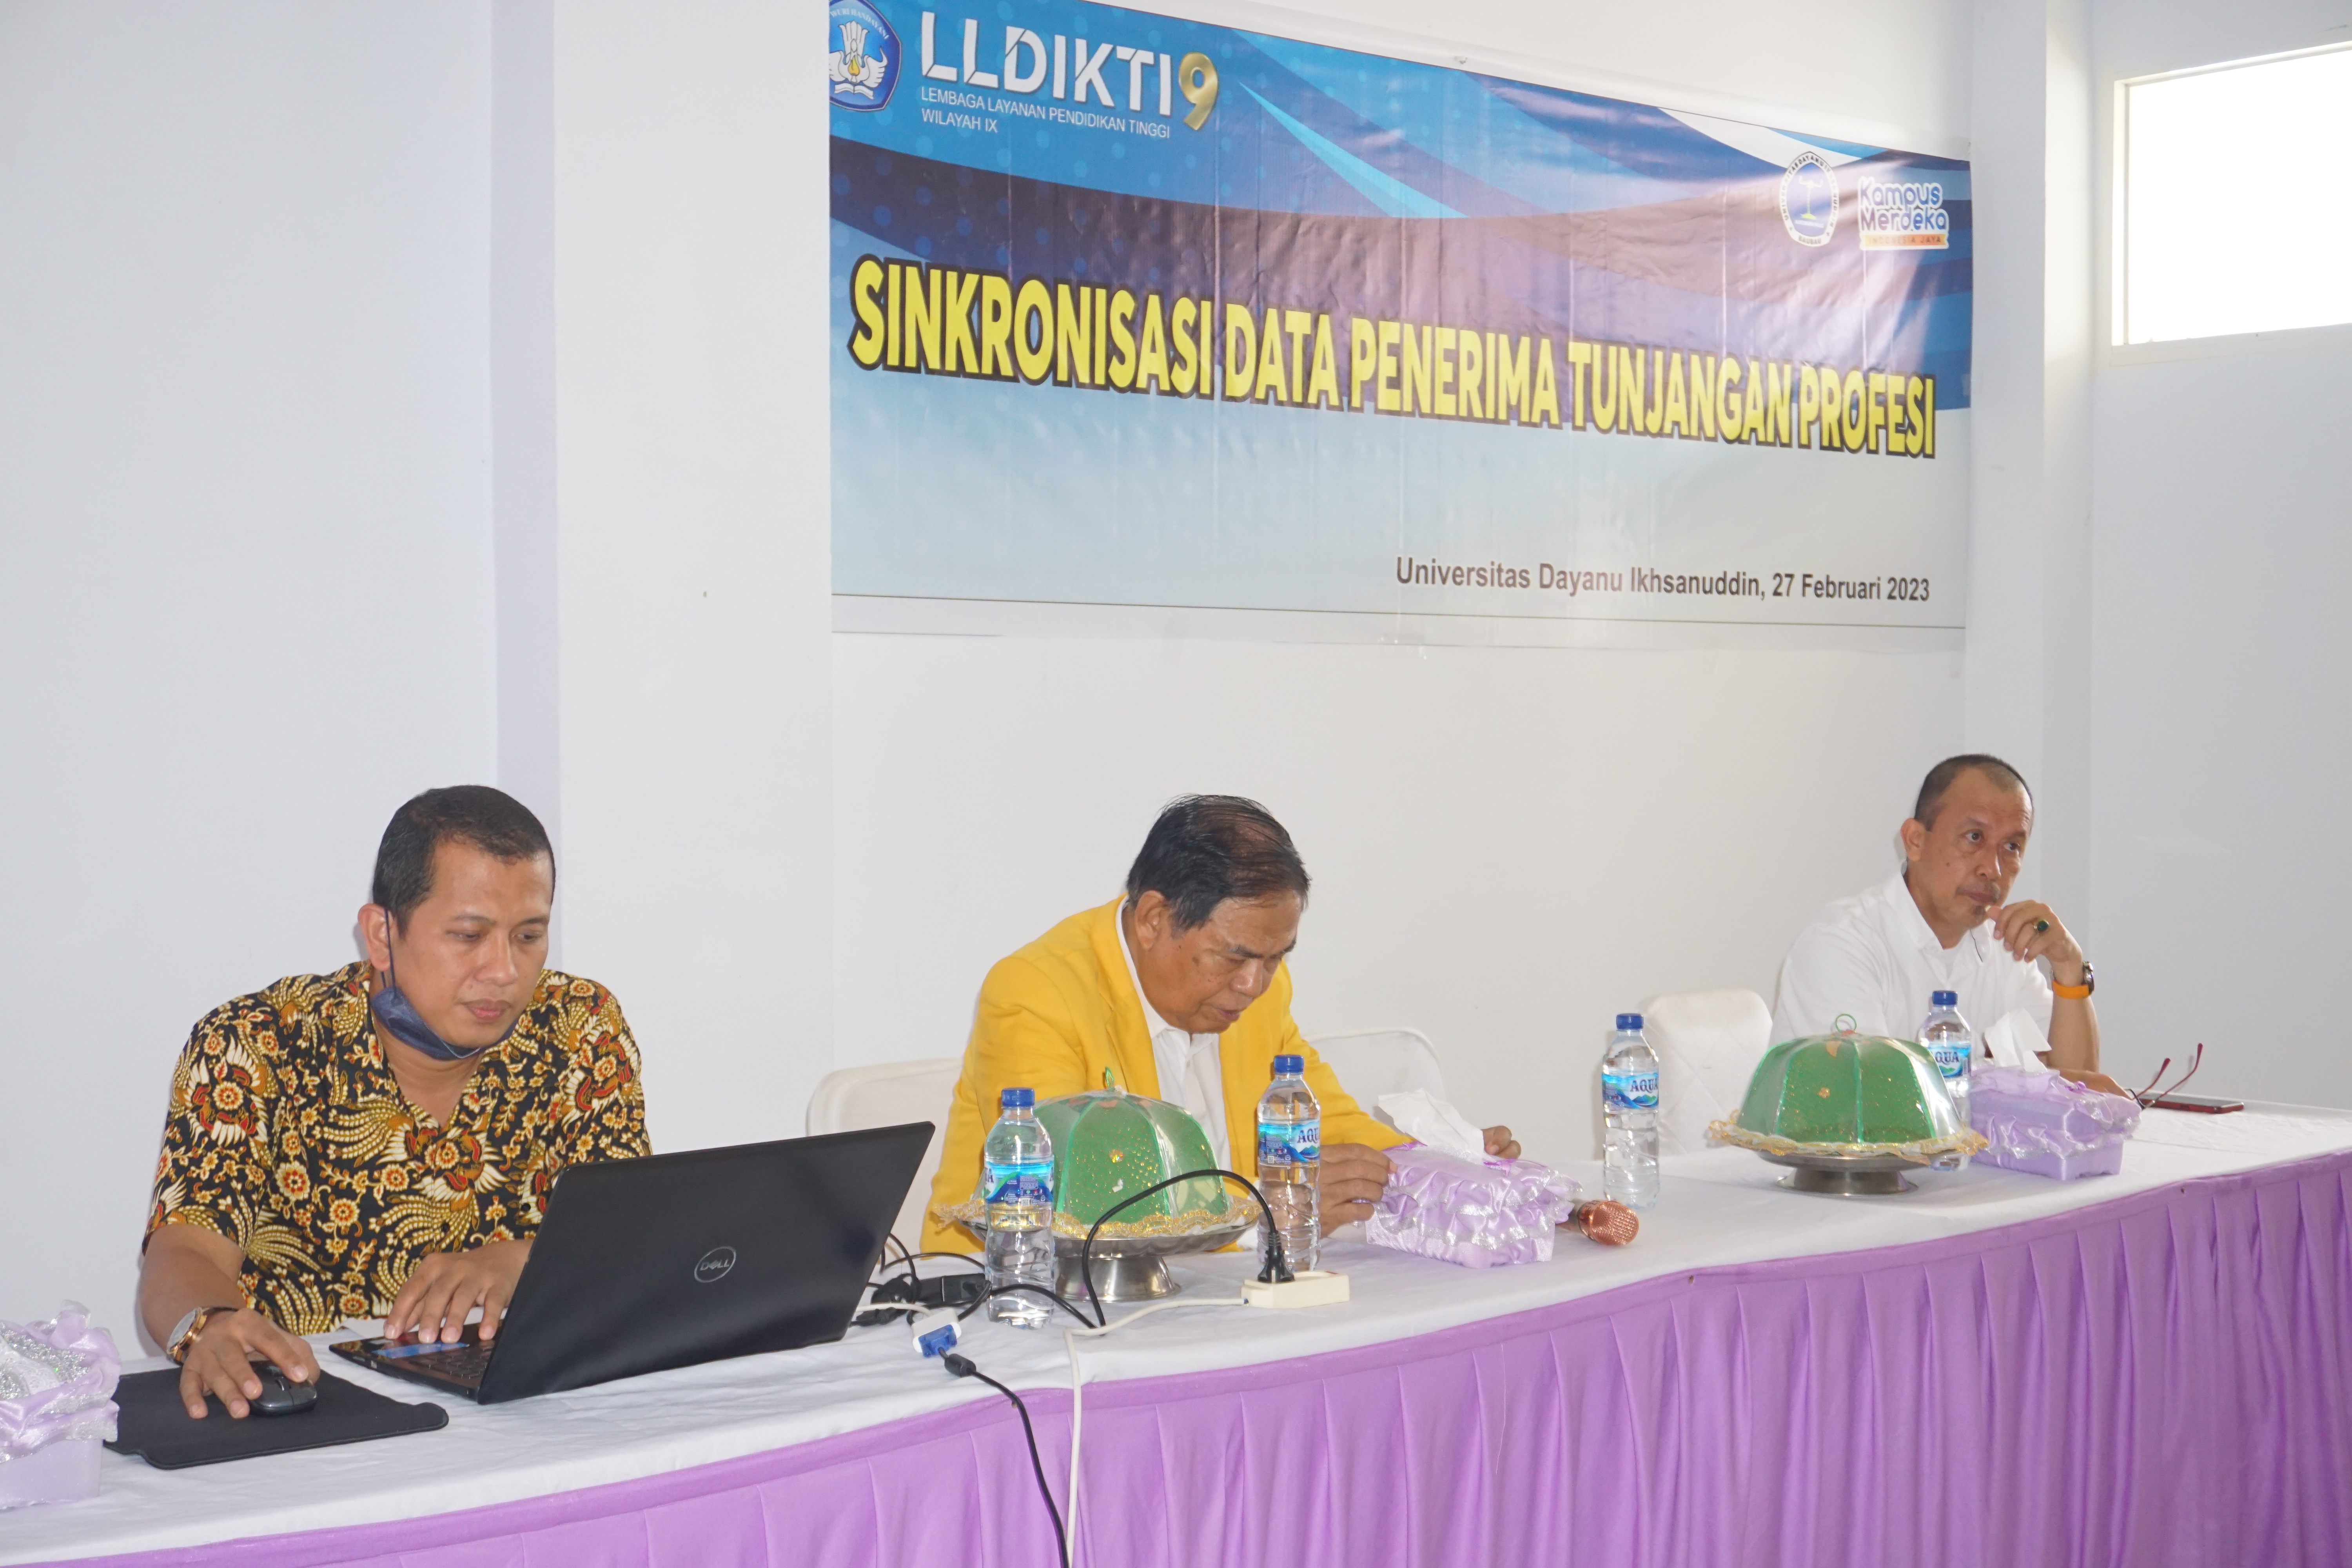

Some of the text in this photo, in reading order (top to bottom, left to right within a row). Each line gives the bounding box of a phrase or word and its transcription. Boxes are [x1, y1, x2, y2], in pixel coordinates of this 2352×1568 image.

[921, 86, 1170, 138] LEMBAGA LAYANAN PENDIDIKAN TINGGI
[922, 108, 998, 133] WILAYAH IX
[1860, 180, 1941, 212] Kampus
[1860, 205, 1947, 231] Merdeka
[853, 261, 1933, 455] SINKRONISASI DATA PENERIMA TUNJANGAN PROFESI
[1396, 557, 1929, 601] Universitas Dayanu Ikhsanuddin, 27 Februari 2023
[1933, 1051, 1959, 1065] QUA
[1630, 1078, 1658, 1093] AQUA
[1297, 1128, 1319, 1143] AQU
[700, 1259, 730, 1271] DELL
